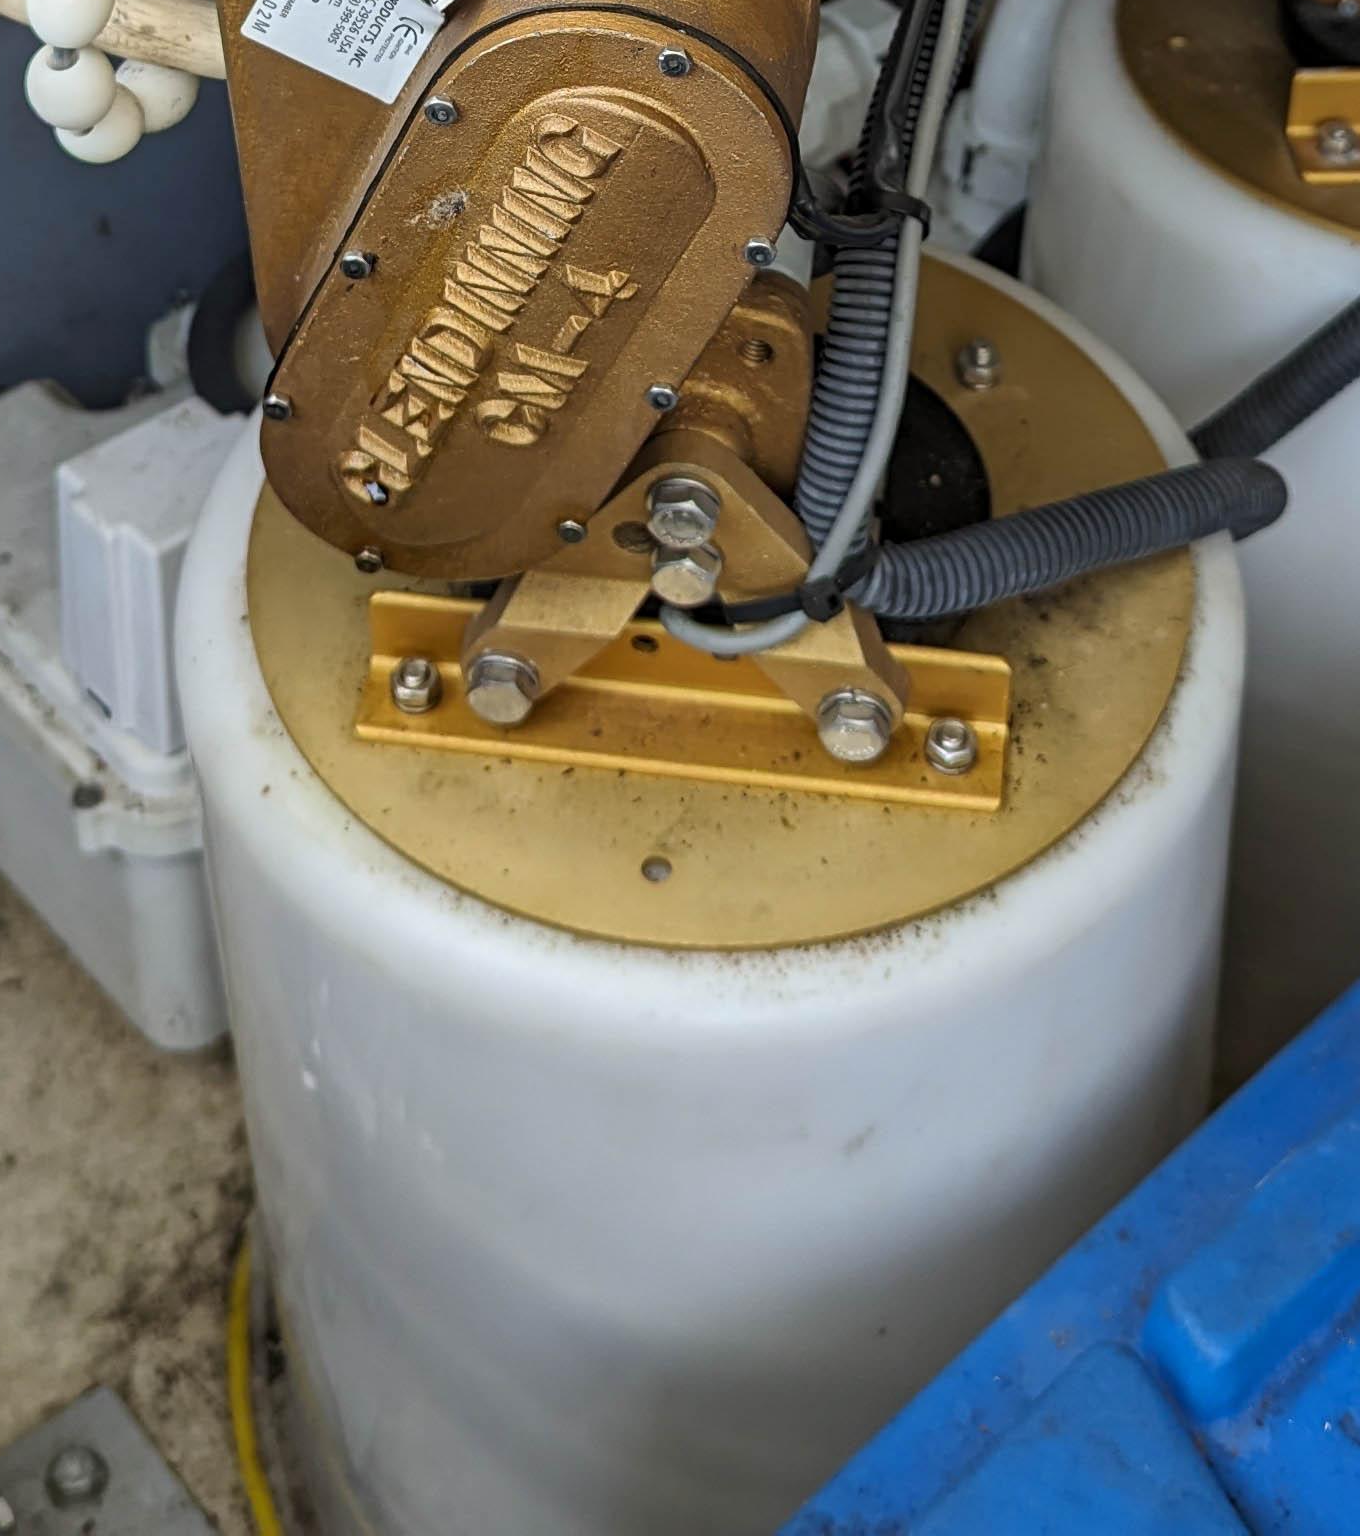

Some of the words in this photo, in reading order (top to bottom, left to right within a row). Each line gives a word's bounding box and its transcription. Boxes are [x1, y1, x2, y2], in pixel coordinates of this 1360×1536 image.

[326, 5, 355, 45] 399-5005
[348, 5, 371, 35] 29526
[335, 33, 355, 55] USA
[372, 32, 394, 63] PROTECTED
[337, 112, 624, 504] GLENDINNING
[475, 264, 639, 446] CM-4
